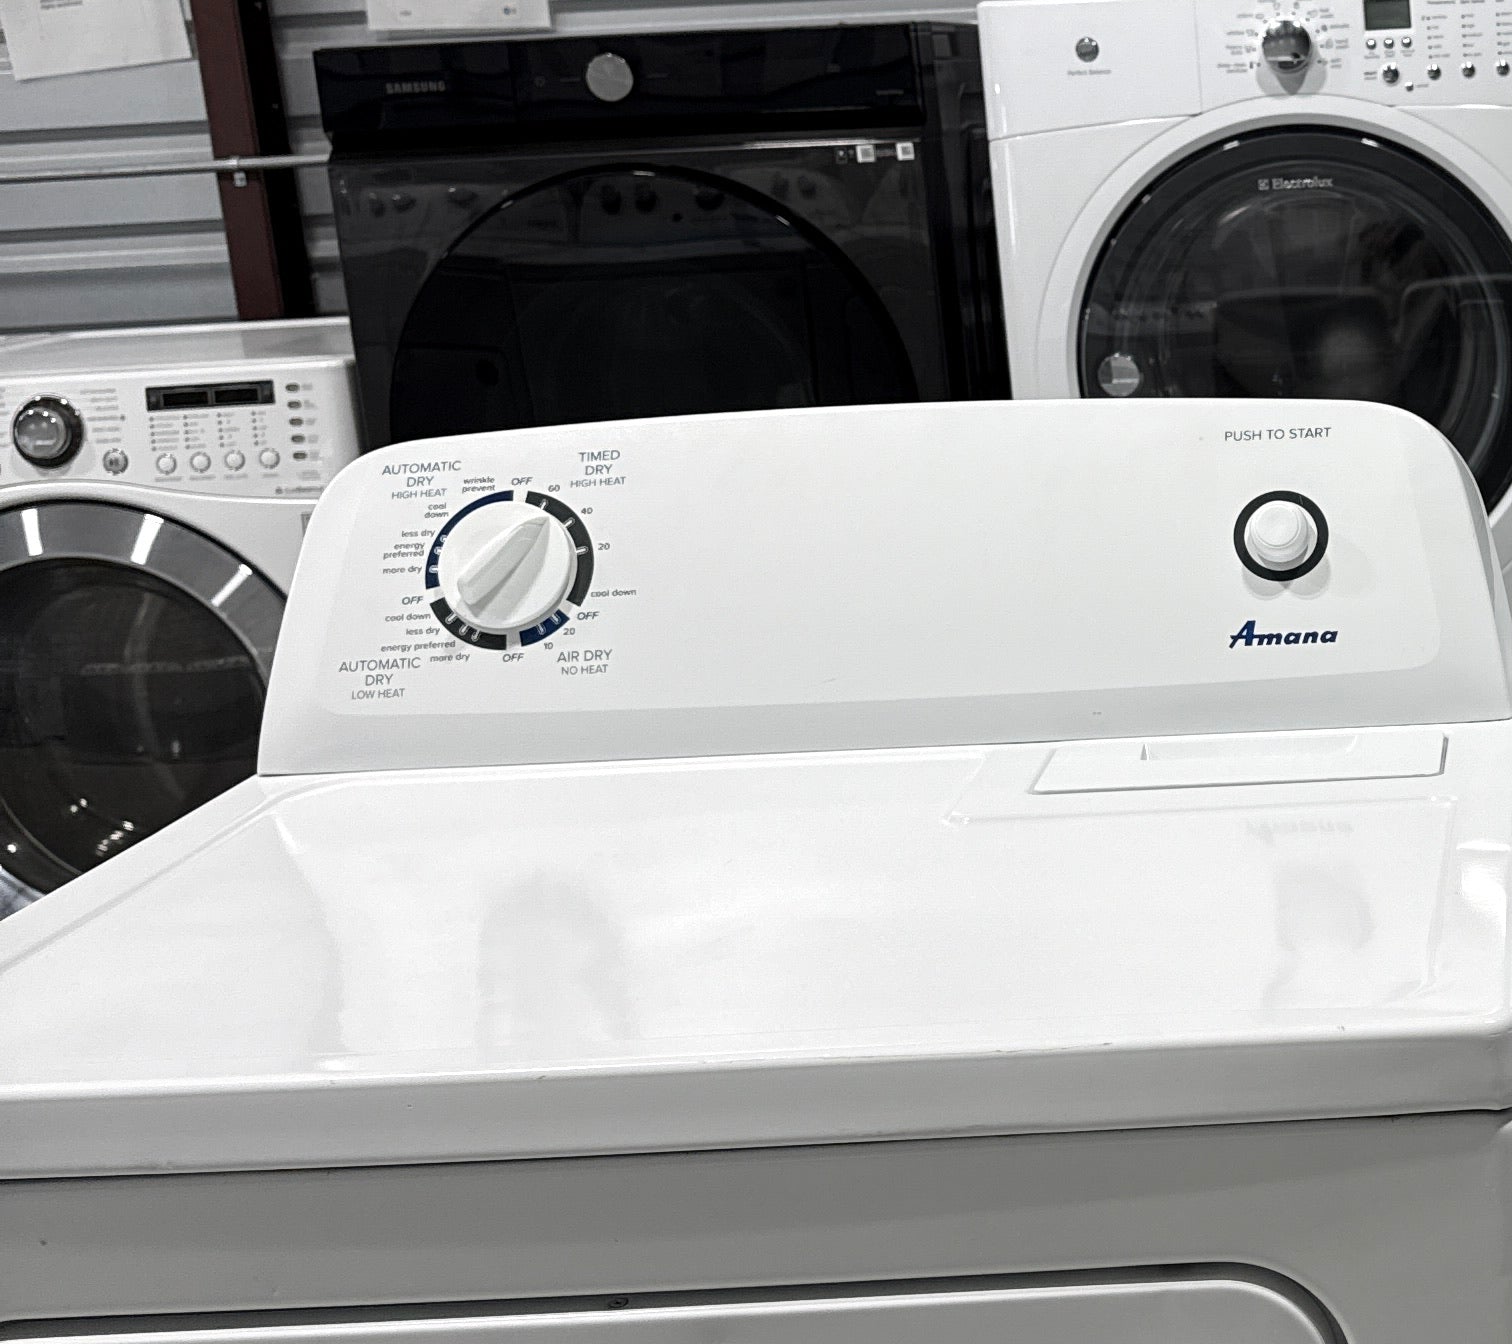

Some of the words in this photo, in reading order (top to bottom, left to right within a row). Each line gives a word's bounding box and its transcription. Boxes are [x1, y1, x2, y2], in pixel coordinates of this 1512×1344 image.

[385, 80, 446, 95] SAMSUNG
[1272, 176, 1334, 191] Electrolux
[1224, 430, 1262, 442] PUSH
[1267, 428, 1285, 441] TO
[1288, 426, 1332, 439] START
[579, 450, 621, 463] TIMED
[382, 460, 462, 476] AUTOMATIC
[585, 464, 613, 476] DRY
[406, 475, 434, 487] DRY
[463, 476, 496, 485] wrinkle
[511, 476, 533, 486] OFF
[570, 478, 597, 488] HIGH
[599, 476, 627, 487] HEAT
[391, 490, 418, 500] HIGH
[420, 488, 447, 499] HEAT
[462, 484, 496, 494] prevent
[547, 484, 561, 493] 60
[428, 502, 447, 511] cool
[581, 506, 593, 515] 40
[424, 510, 449, 519] down
[401, 529, 419, 538] less
[420, 528, 436, 538] dry
[393, 541, 425, 551] energy
[598, 542, 610, 551] 20
[383, 548, 425, 560] preferred
[382, 566, 406, 574] more
[408, 564, 423, 575] dry
[590, 589, 609, 598] cool
[611, 588, 637, 597] down
[401, 595, 424, 606] OFF
[385, 612, 403, 622] cool
[405, 611, 431, 621] down
[577, 611, 600, 621] OFF
[405, 627, 424, 636] less
[425, 625, 440, 636] dry
[563, 627, 576, 636] 20
[1228, 620, 1338, 649] Amana
[380, 643, 412, 653] energy
[413, 640, 456, 652] preferred
[543, 641, 554, 651] 10
[430, 654, 454, 663] more
[456, 652, 471, 663] dry
[502, 652, 524, 663] OFF
[557, 651, 579, 663] AIR
[582, 649, 613, 662] DRY
[338, 657, 422, 673] AUTOMATIC
[561, 665, 578, 675] NO
[580, 664, 609, 675] HEAT
[364, 673, 393, 687] DRY
[351, 689, 376, 700] LOW
[377, 688, 405, 699] HEAT
